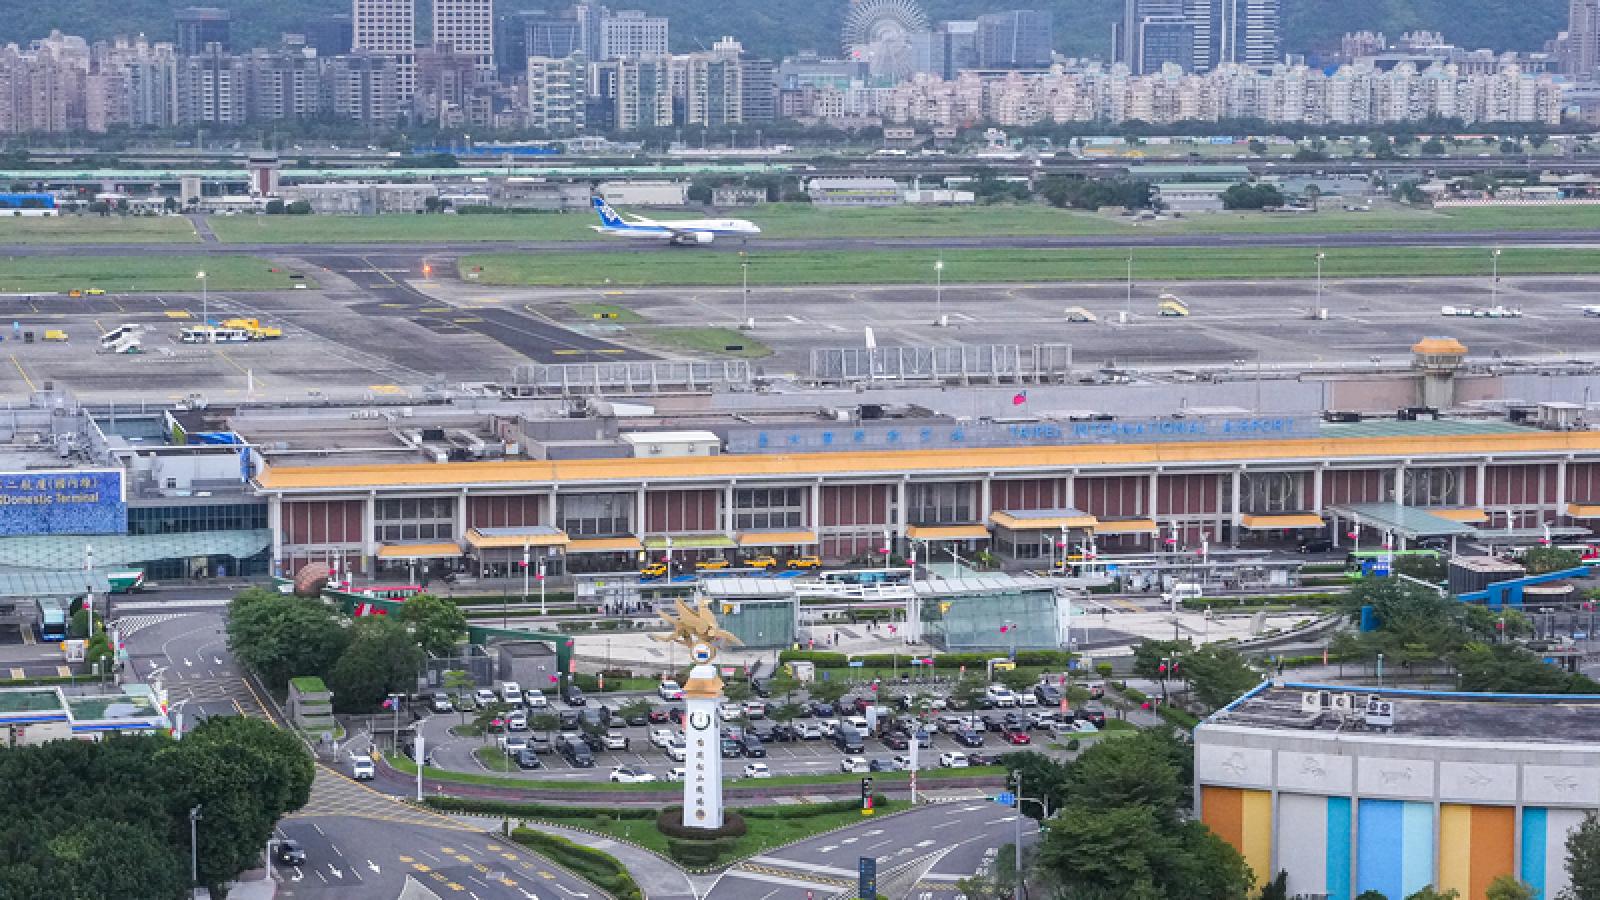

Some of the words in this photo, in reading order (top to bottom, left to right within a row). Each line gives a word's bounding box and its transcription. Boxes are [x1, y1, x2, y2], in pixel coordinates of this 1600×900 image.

[1009, 422, 1061, 437] TAIPEI
[1072, 419, 1206, 436] INTERNATIONAL
[1223, 416, 1295, 433] AIRPORT
[56, 491, 99, 503] Terminal
